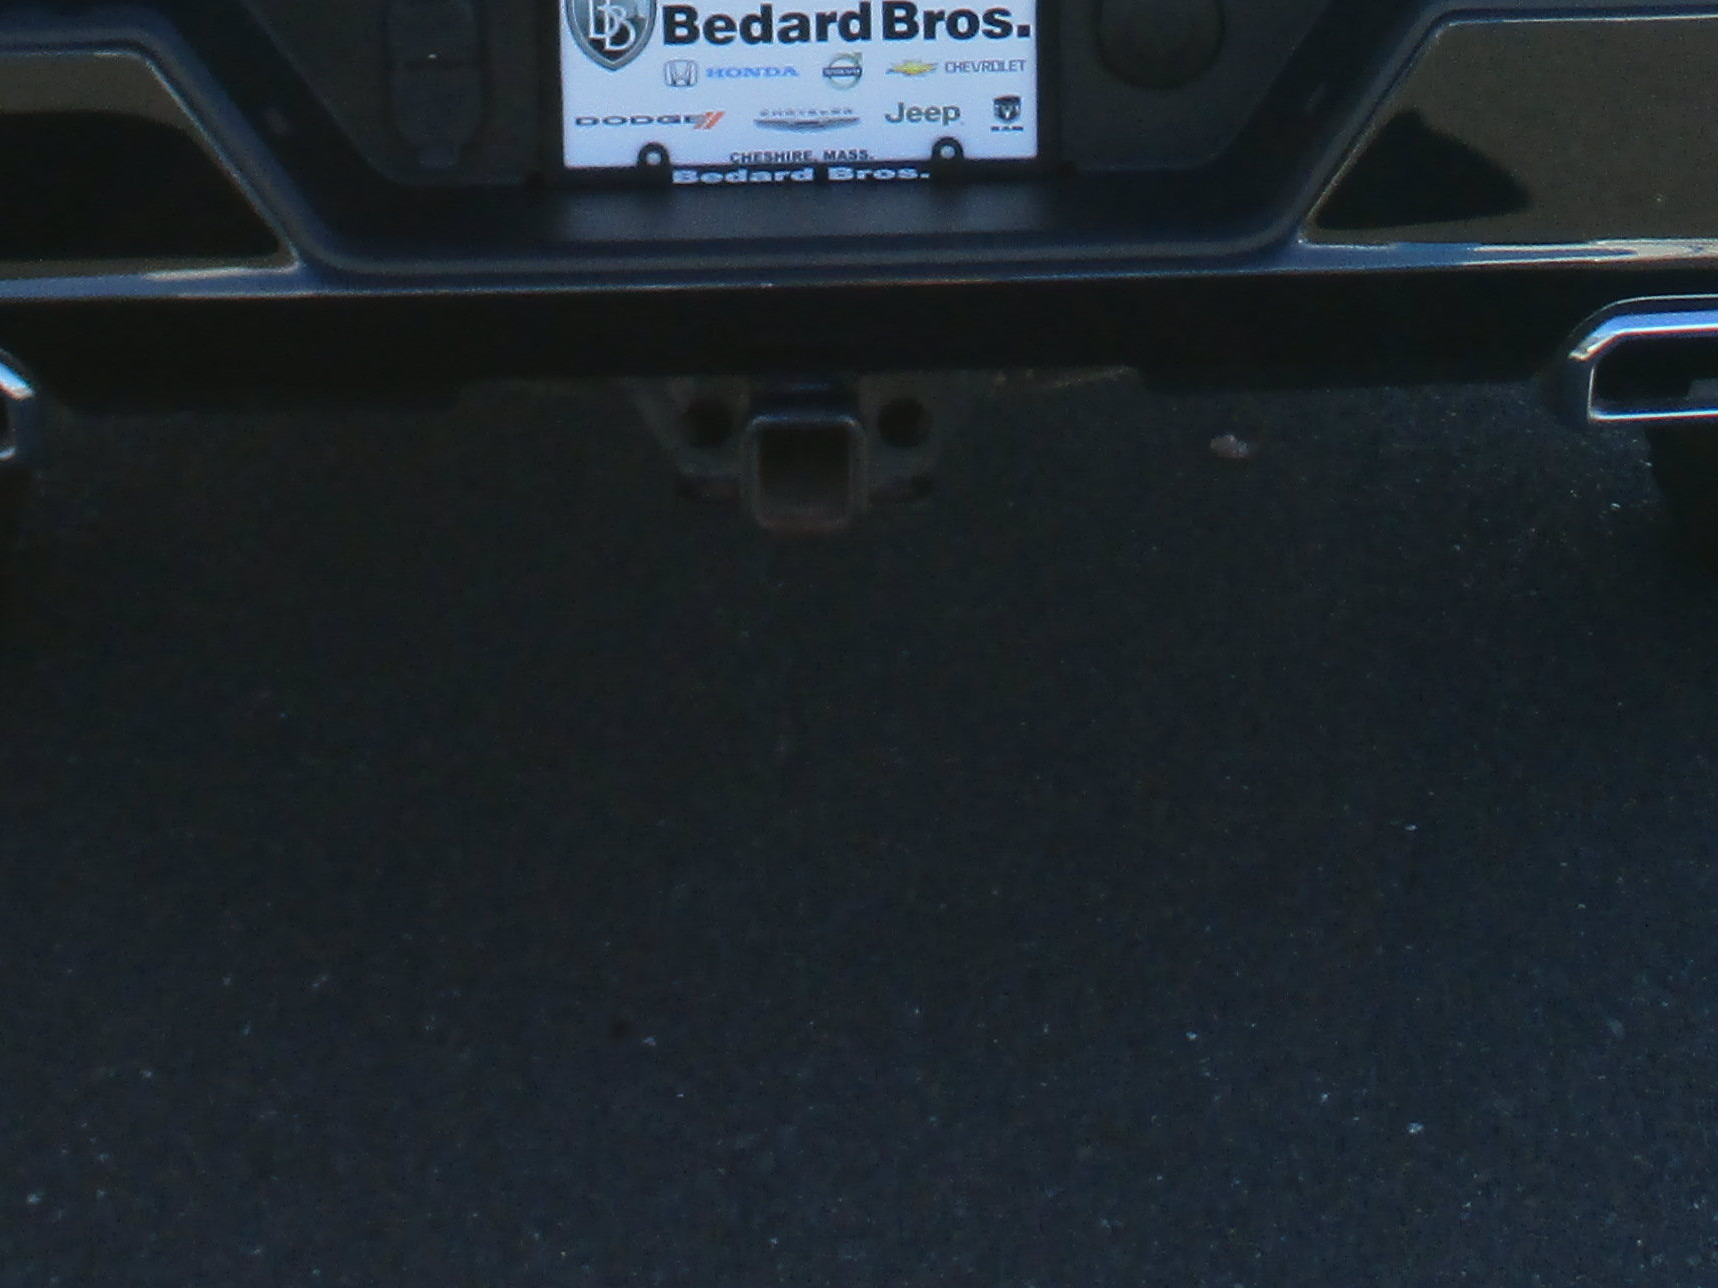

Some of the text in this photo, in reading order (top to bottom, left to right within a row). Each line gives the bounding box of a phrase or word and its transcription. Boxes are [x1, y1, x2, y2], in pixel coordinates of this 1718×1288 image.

[663, 0, 1031, 45] Bedard Bros.
[706, 67, 799, 78] HONDA
[945, 60, 1027, 73] CHEVROLET
[576, 114, 708, 126] DODGE
[885, 102, 961, 125] Jeep
[823, 149, 874, 162] MASS.
[673, 166, 930, 184] Bedard Bros.
